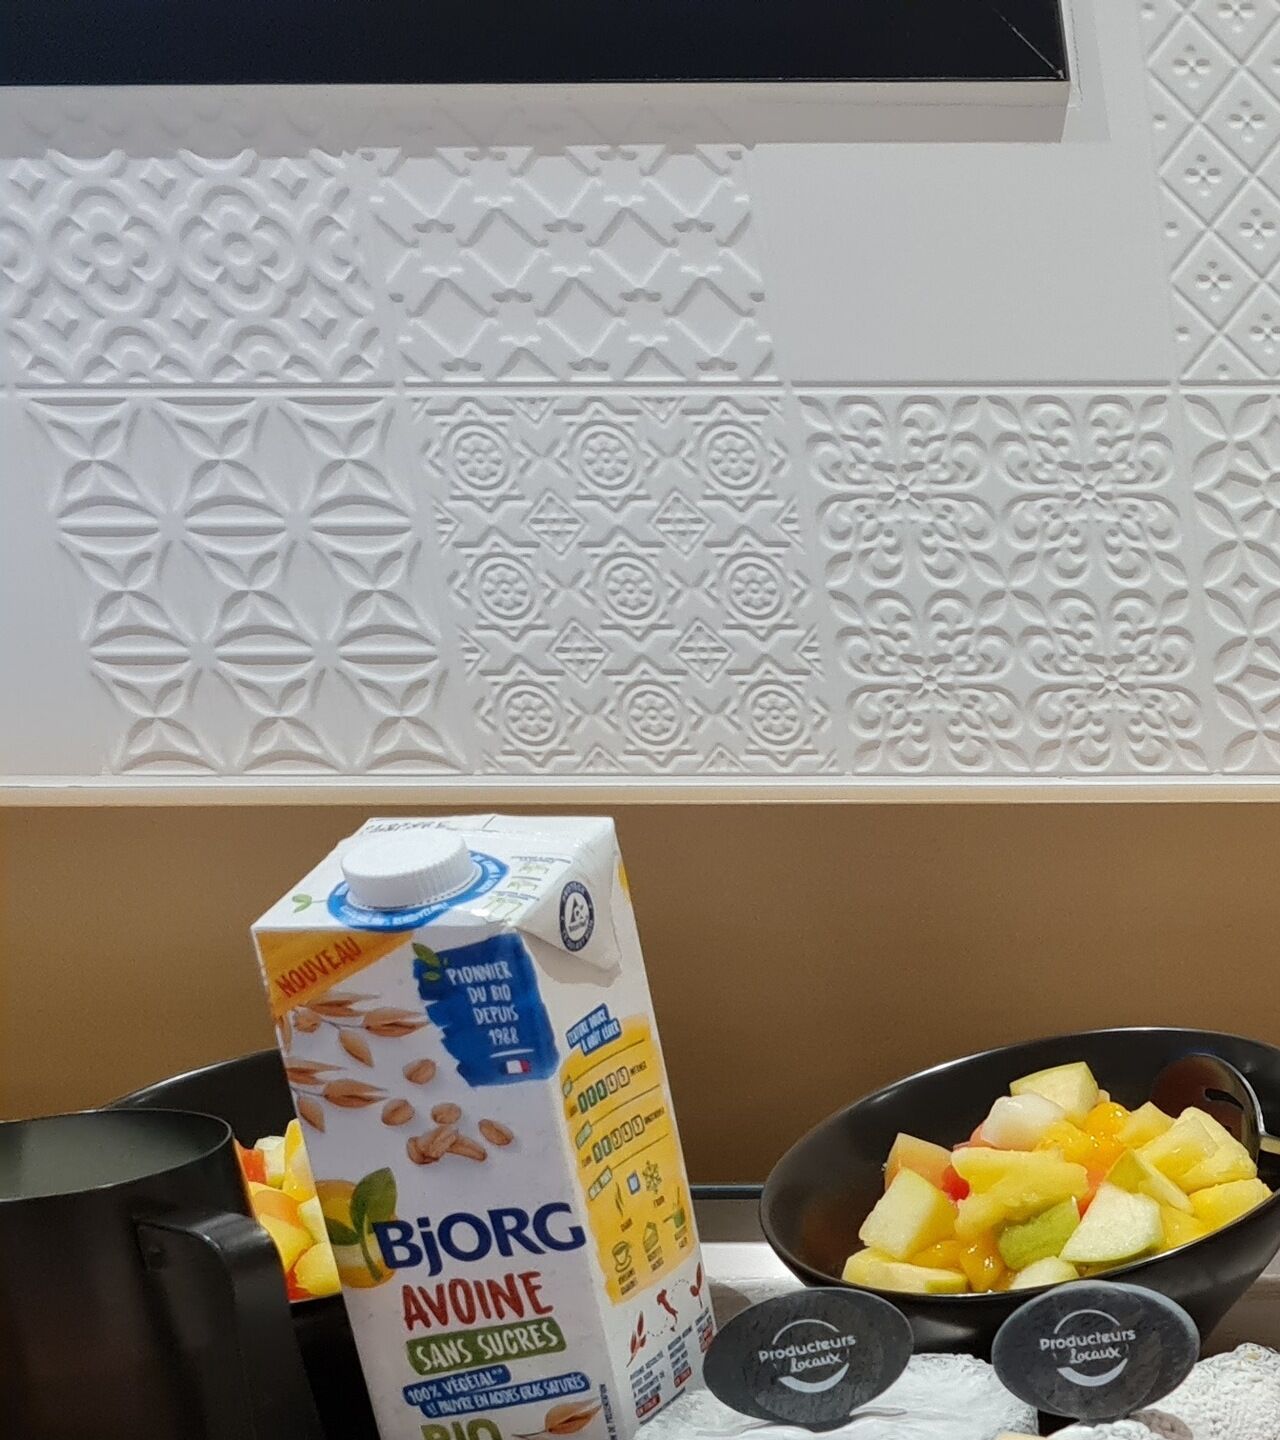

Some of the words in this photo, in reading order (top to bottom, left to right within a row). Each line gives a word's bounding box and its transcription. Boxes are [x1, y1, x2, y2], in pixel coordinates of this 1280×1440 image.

[274, 937, 363, 998] NOUVEAU
[446, 961, 513, 986] PIONNIER
[468, 987, 488, 1002] DU
[490, 984, 512, 1001] BIO
[473, 1006, 520, 1026] DEPUIS
[488, 1027, 519, 1046] 1988
[401, 1271, 554, 1331] AVOINE
[417, 1338, 473, 1371] SANS
[477, 1324, 560, 1357] SUCRES
[758, 1334, 857, 1362] Producteurs
[1039, 1328, 1137, 1352] Producteurs
[408, 1384, 442, 1403] 100%
